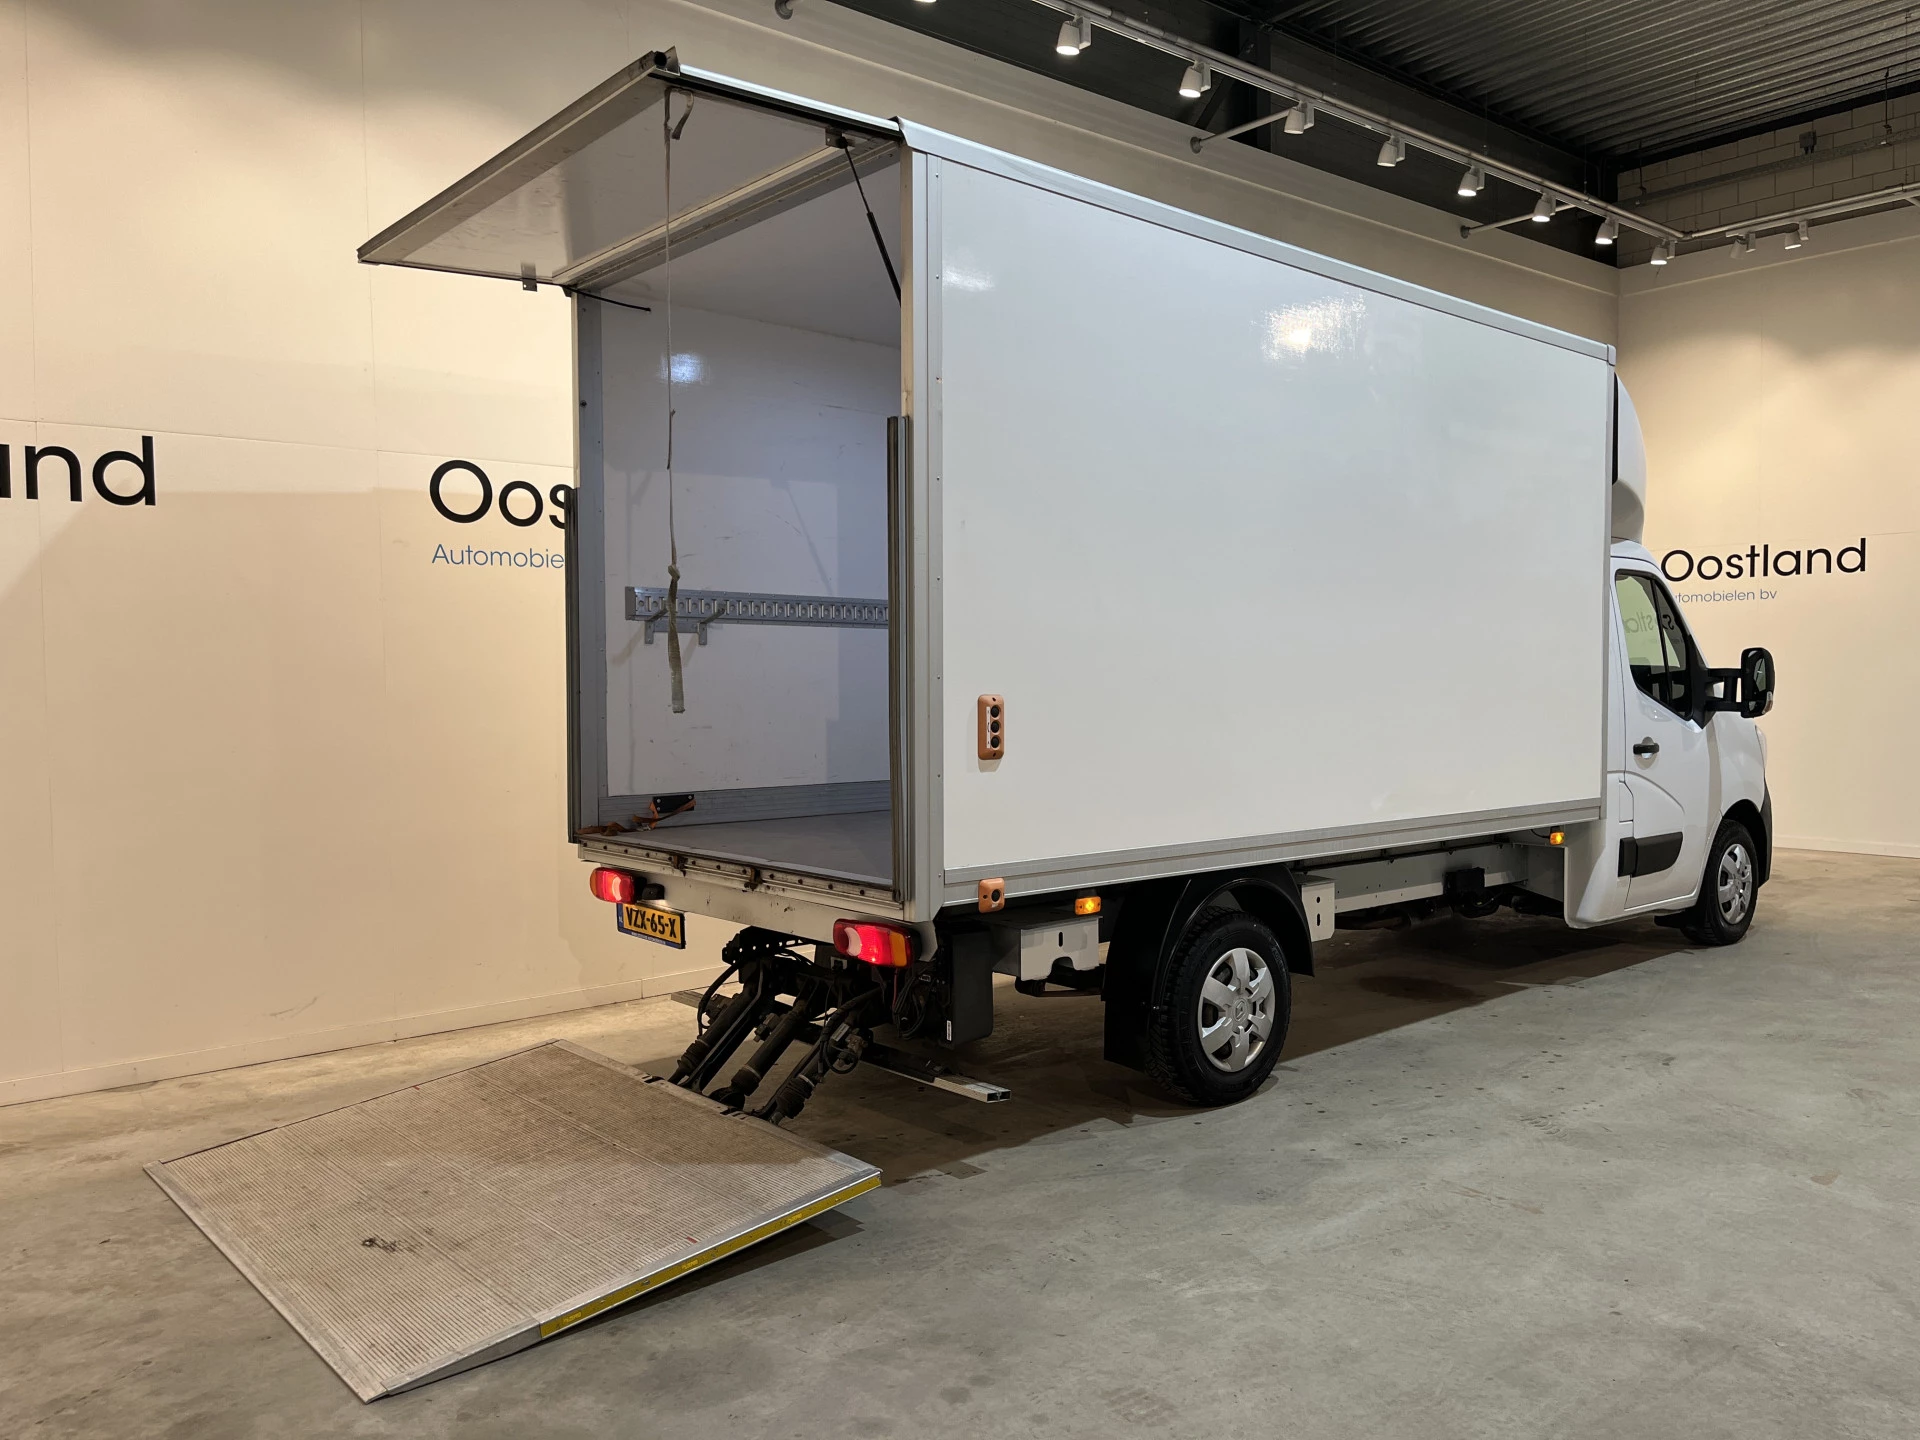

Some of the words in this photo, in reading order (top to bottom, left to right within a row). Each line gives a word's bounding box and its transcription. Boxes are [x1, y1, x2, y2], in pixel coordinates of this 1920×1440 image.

[0, 435, 156, 506] nd
[431, 543, 565, 569] Automobie
[1661, 537, 1866, 582] Oostland
[1675, 590, 1755, 603] tomobielen
[1760, 588, 1778, 600] bv
[626, 906, 677, 938] VZX-65-X
